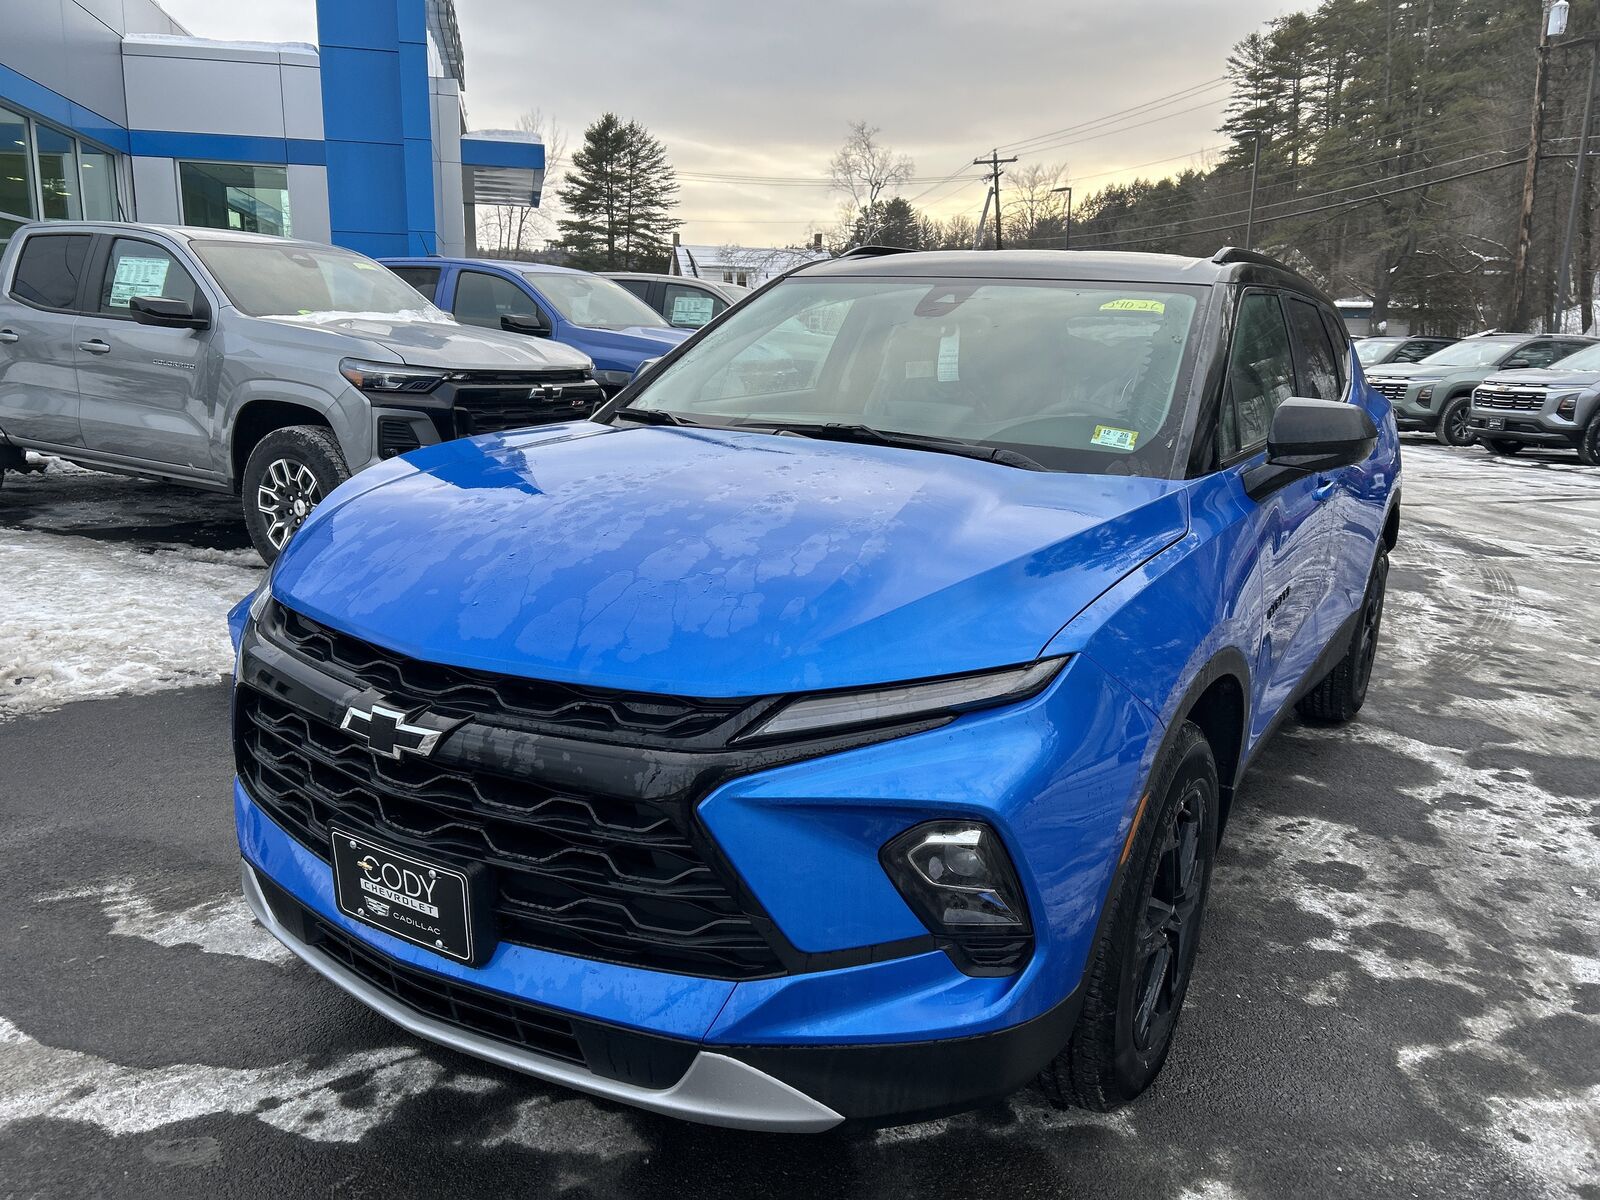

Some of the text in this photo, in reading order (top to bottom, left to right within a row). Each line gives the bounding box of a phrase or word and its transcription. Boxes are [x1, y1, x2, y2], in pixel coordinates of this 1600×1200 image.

[152, 358, 196, 370] COLORADO
[362, 855, 437, 903] CODY
[364, 881, 435, 915] CHEVROLET
[392, 912, 441, 936] CADILLAC
